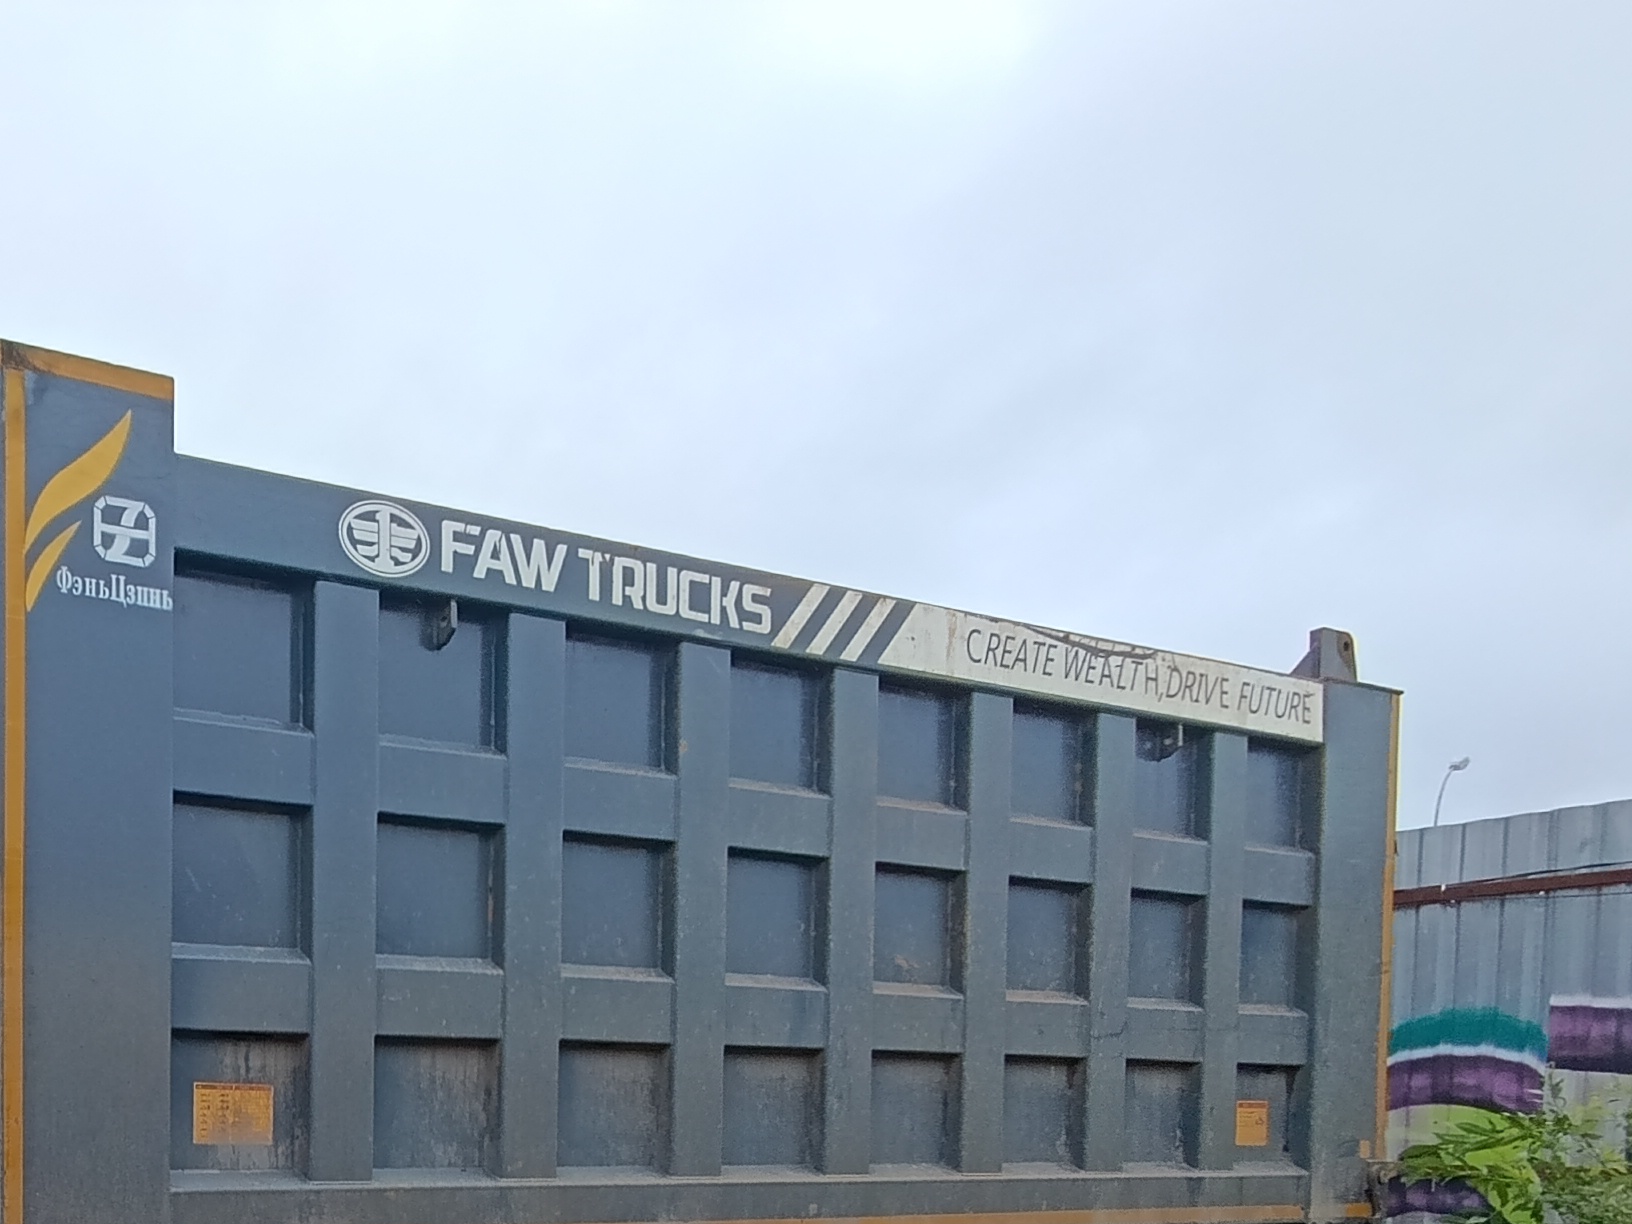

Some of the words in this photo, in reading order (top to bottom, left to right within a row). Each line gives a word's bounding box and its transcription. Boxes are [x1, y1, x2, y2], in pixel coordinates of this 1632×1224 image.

[441, 519, 568, 593] FAW
[578, 548, 772, 635] TRUCKS
[965, 628, 1059, 677] CREATE
[1236, 681, 1312, 725] FUTURE
